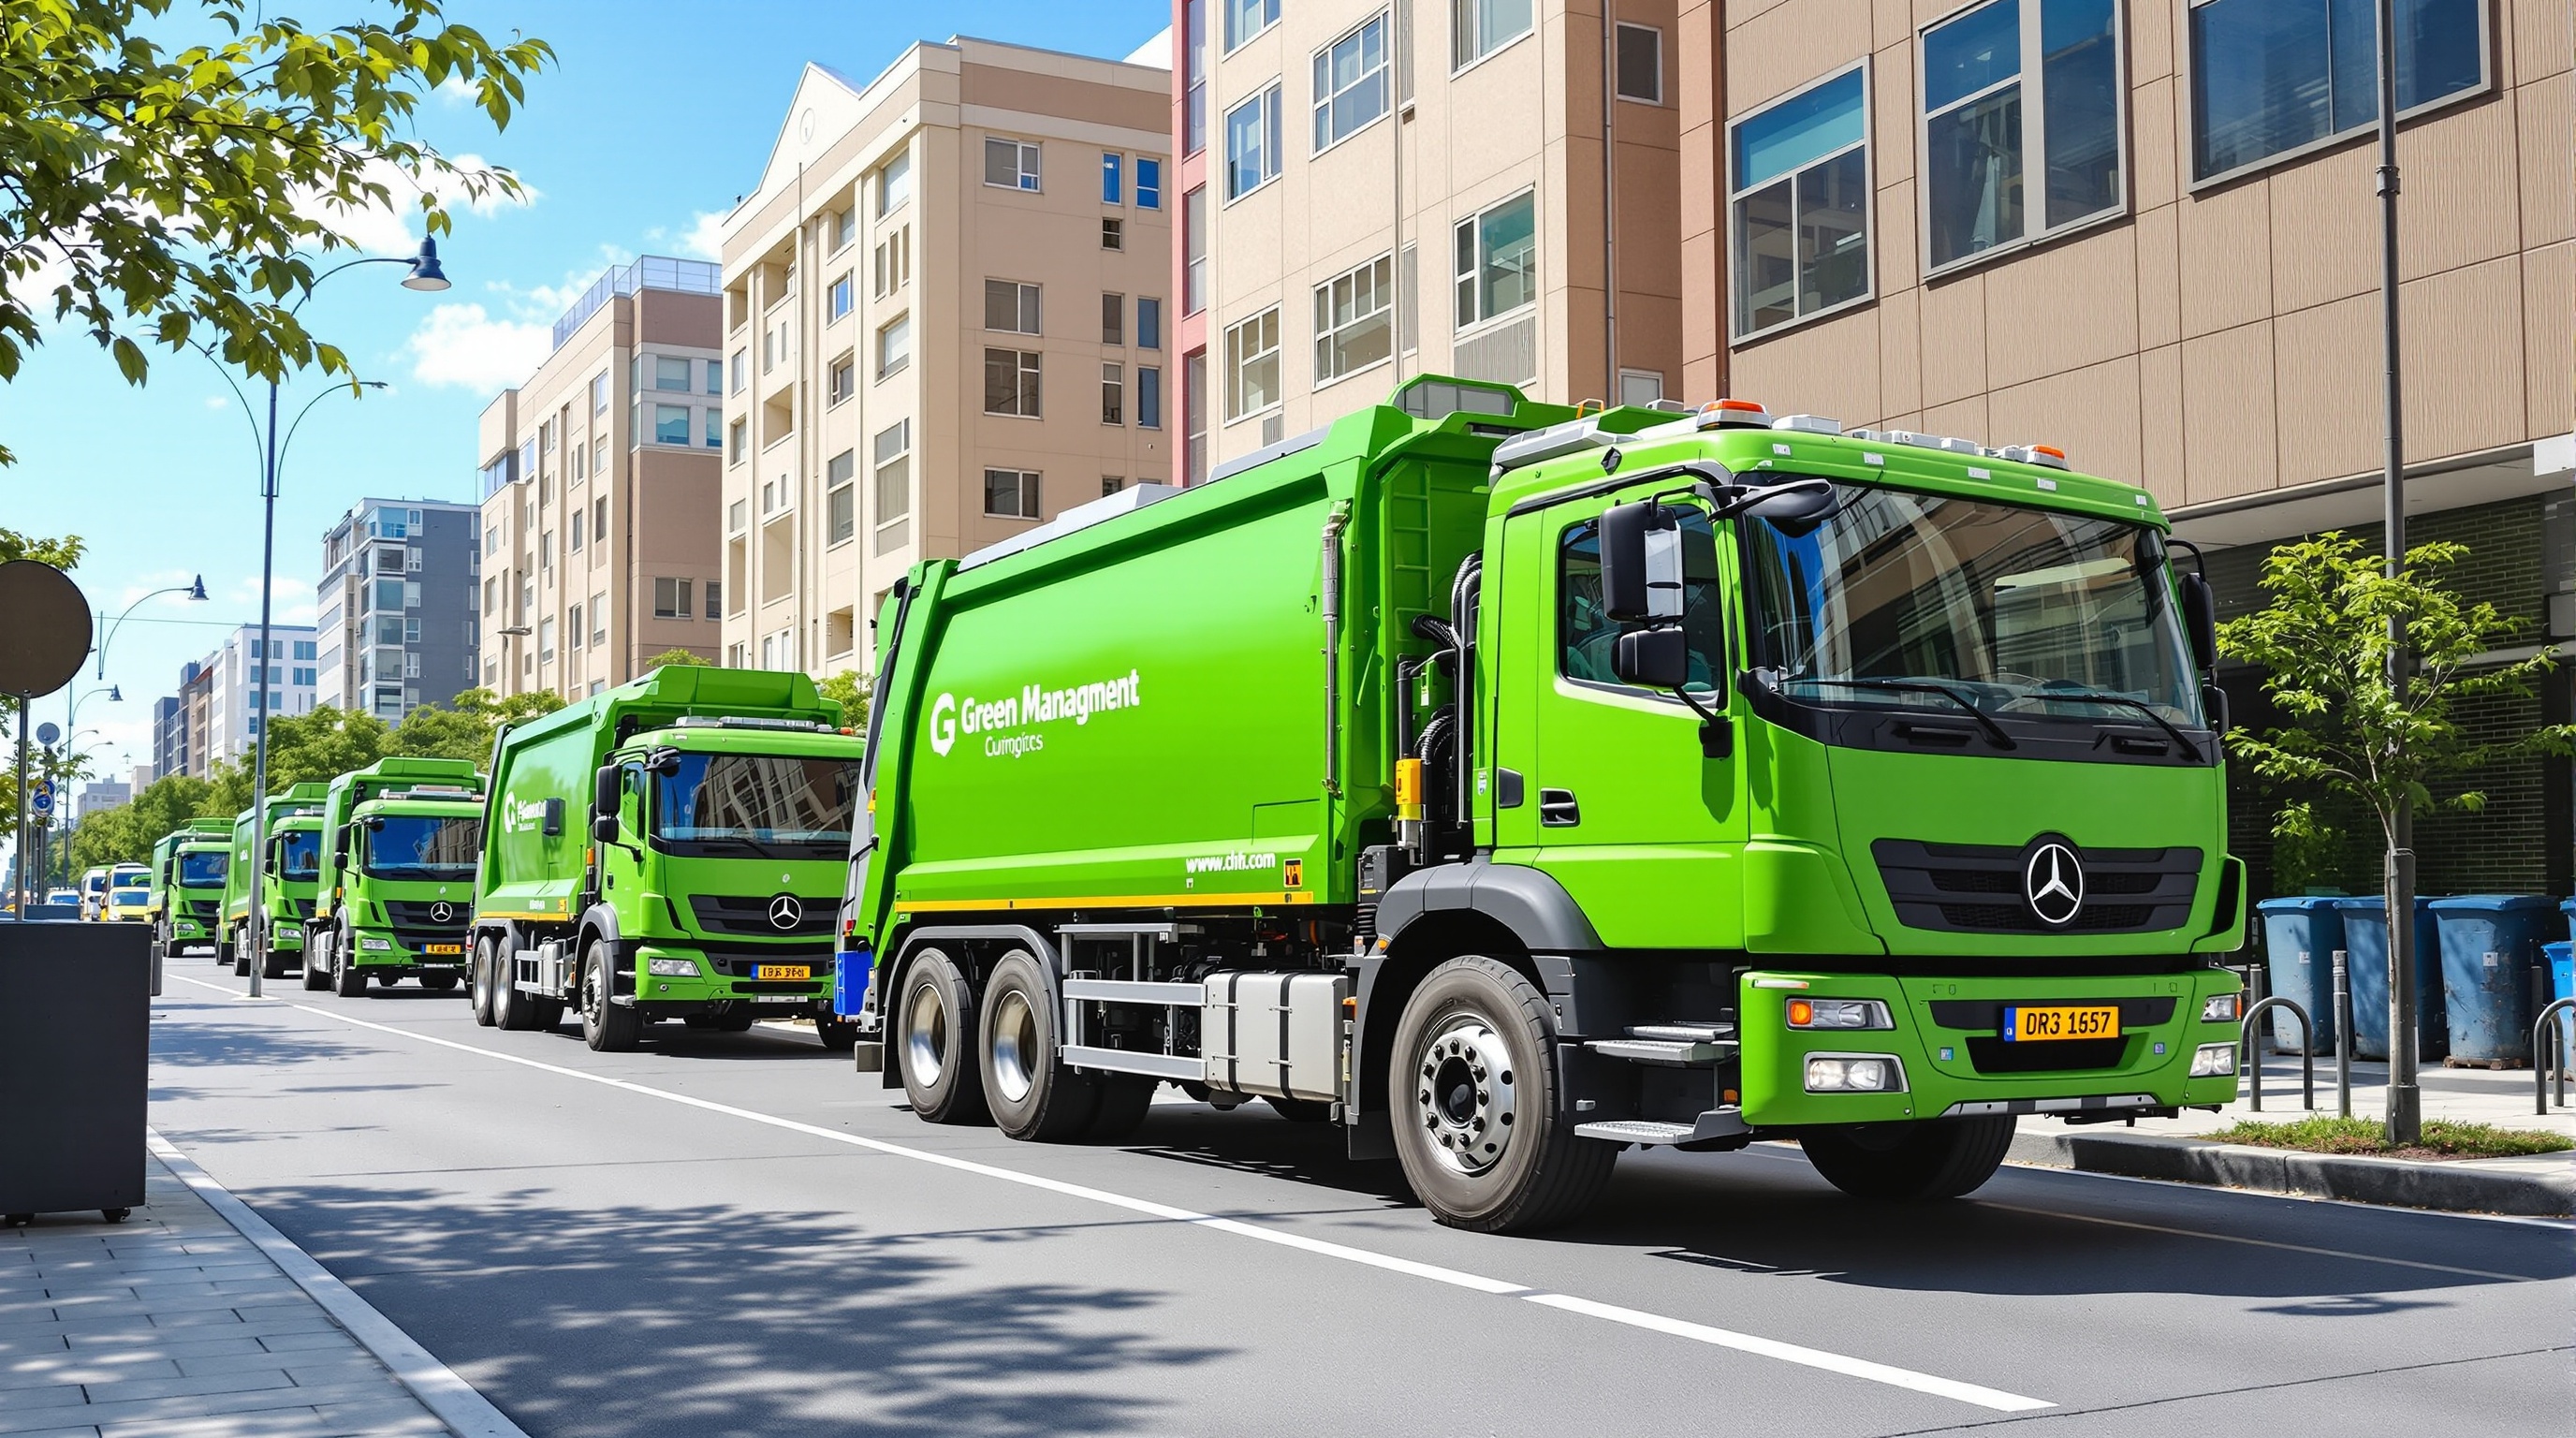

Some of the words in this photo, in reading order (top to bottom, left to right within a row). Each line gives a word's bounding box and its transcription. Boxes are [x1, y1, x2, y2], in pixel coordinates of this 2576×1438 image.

[961, 697, 1017, 734] Green
[1021, 668, 1140, 726] Managment
[2026, 1012, 2061, 1035] DR3
[2068, 1011, 2111, 1034] 1657
